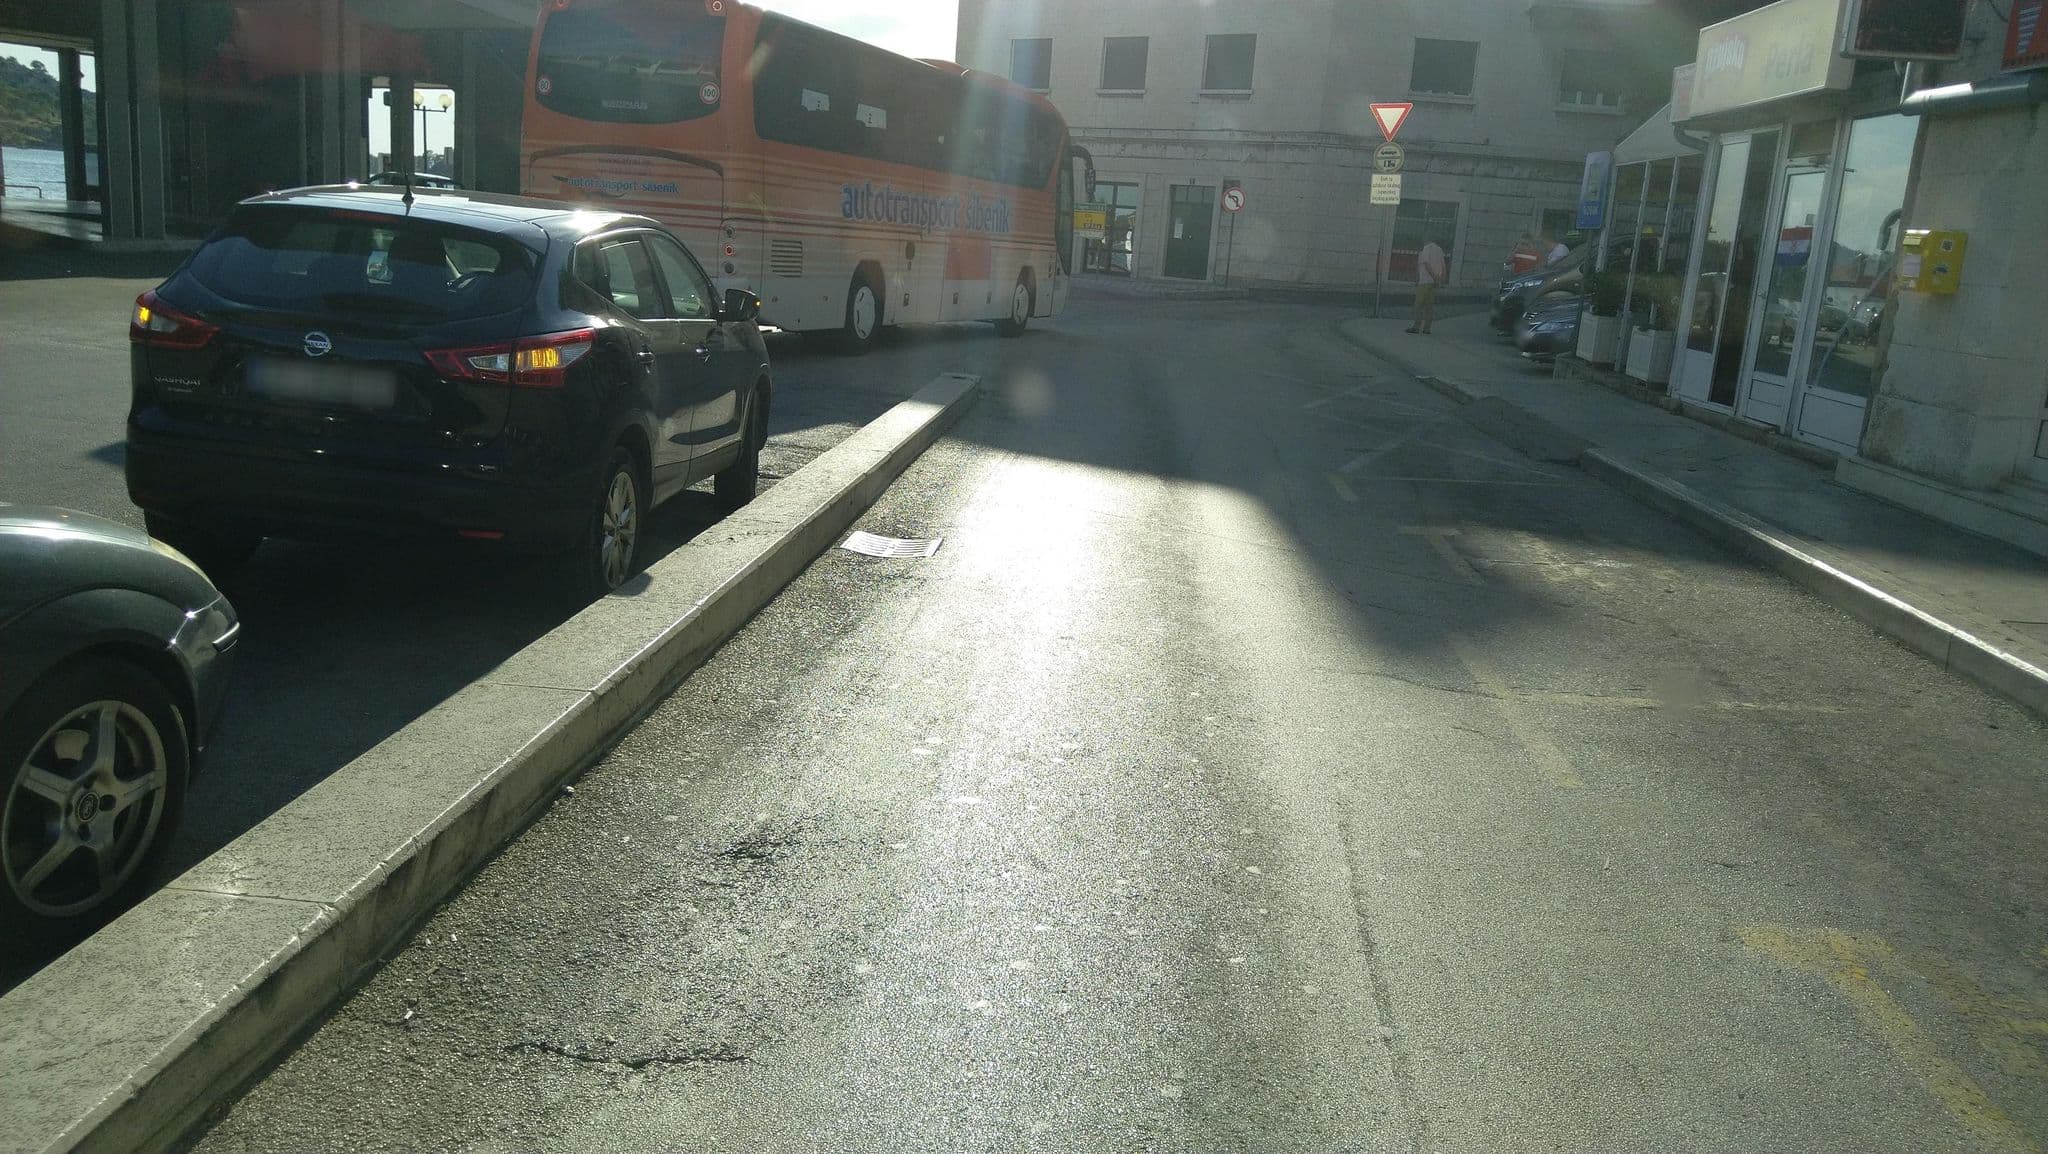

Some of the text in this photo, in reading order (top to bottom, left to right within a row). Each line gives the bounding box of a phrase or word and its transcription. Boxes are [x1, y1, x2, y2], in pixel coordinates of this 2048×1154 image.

[703, 87, 716, 97] 100
[567, 176, 637, 193] autotransport
[842, 181, 961, 233] autotransport
